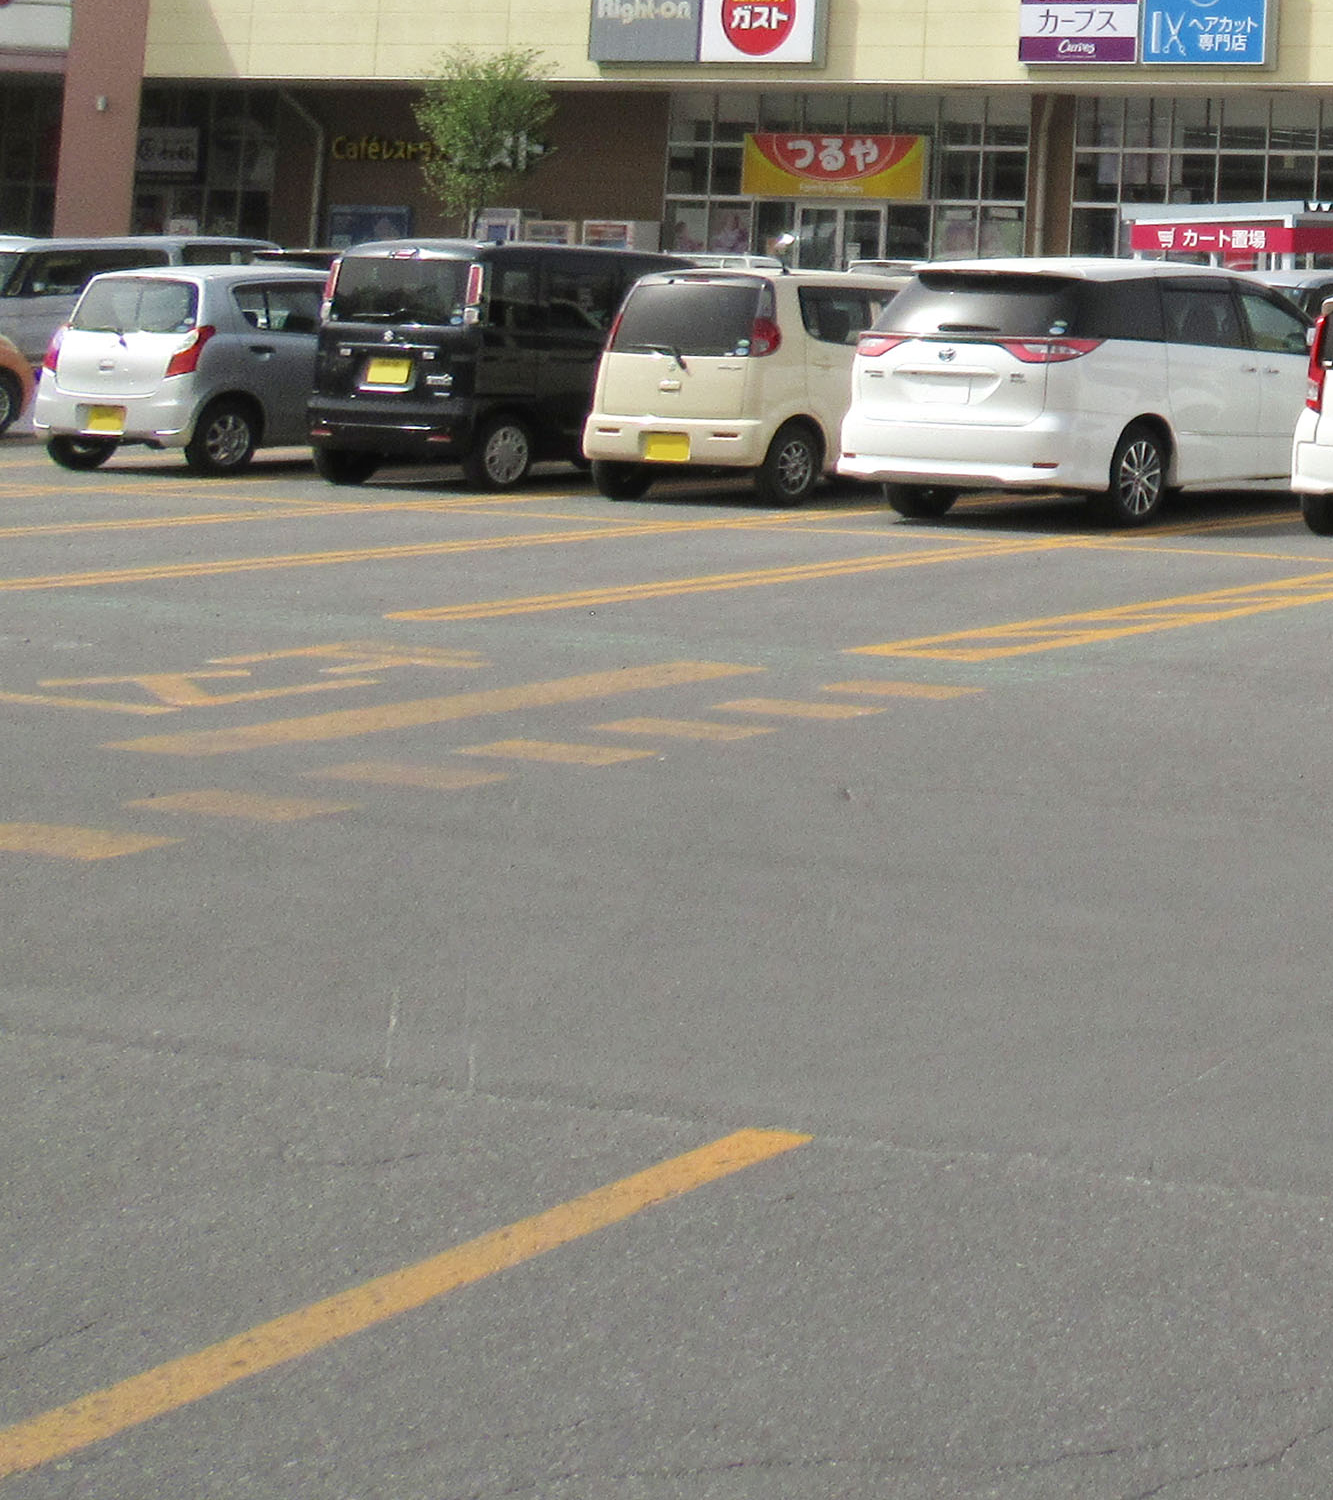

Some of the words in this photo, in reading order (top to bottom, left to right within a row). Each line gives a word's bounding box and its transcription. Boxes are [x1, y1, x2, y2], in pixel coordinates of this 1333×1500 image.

[730, 5, 790, 30] ガスト
[1038, 9, 1118, 33] カーブス
[1189, 17, 1258, 33] ヘアカット
[1057, 39, 1096, 54] Curves
[1198, 34, 1248, 52] 専門店
[787, 139, 878, 172] つるや
[1183, 229, 1266, 249] カート置場
